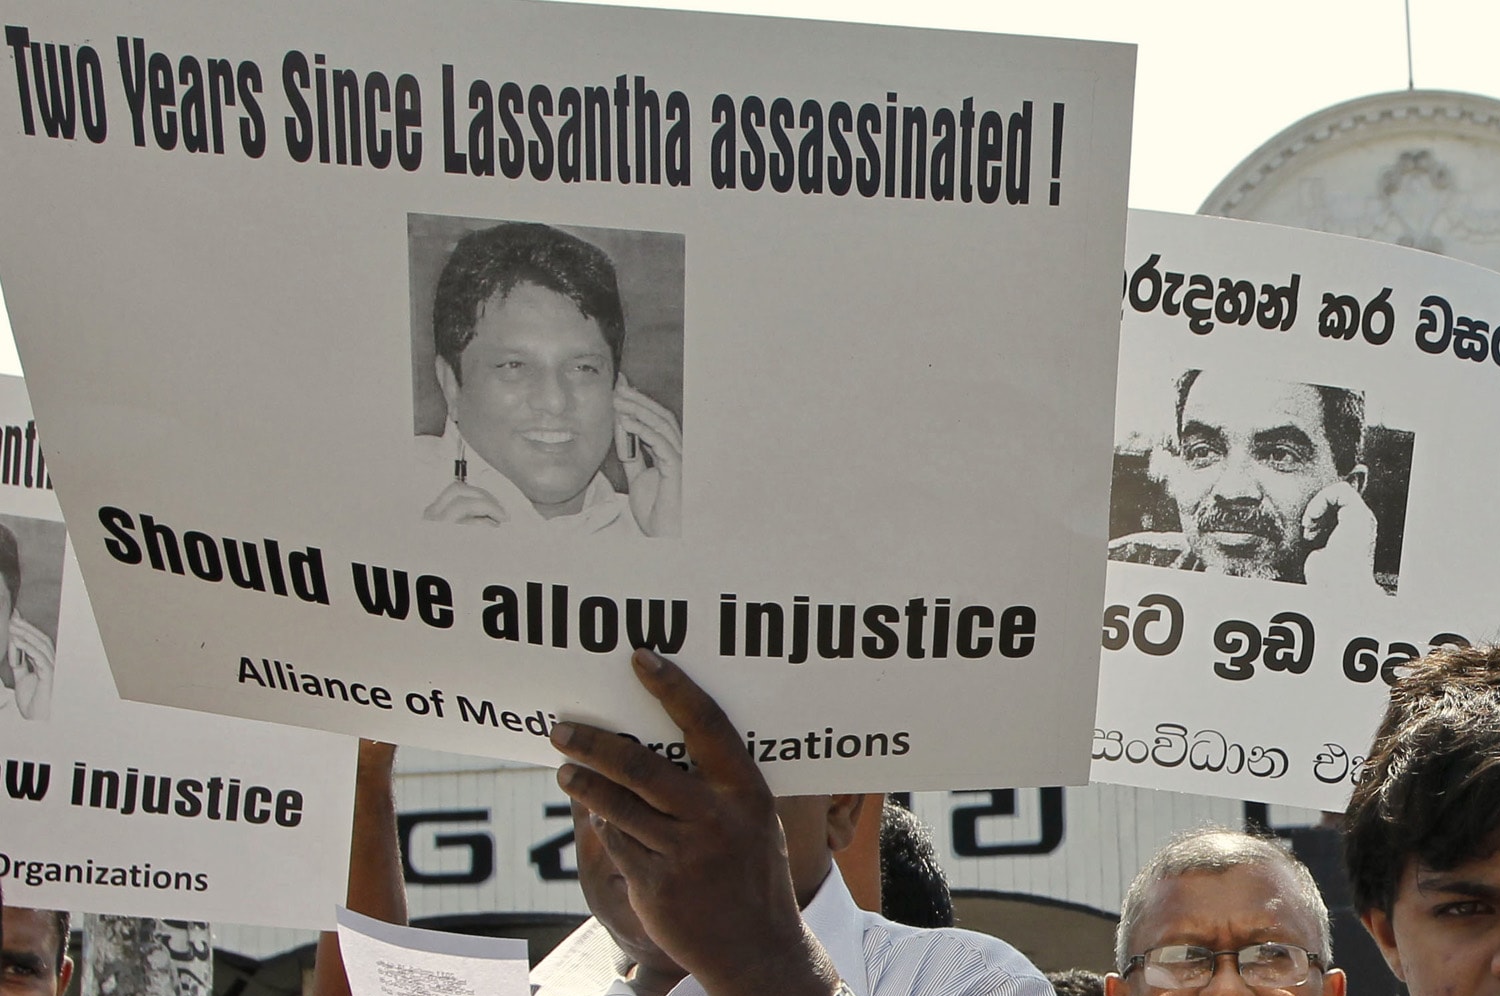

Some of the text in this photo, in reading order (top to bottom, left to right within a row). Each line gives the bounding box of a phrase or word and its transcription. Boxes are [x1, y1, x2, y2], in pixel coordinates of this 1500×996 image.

[5, 25, 1064, 206] Two Years Since Lassantha assassinated !
[1121, 254, 1300, 335] රුදහන්
[1319, 287, 1395, 345] කර
[98, 506, 1036, 664] Should we allow injustice
[1214, 612, 1315, 681] ඉඩ
[239, 657, 392, 709] Alliance
[406, 690, 444, 717] of
[456, 696, 557, 738] Medi
[71, 762, 303, 827] injustice
